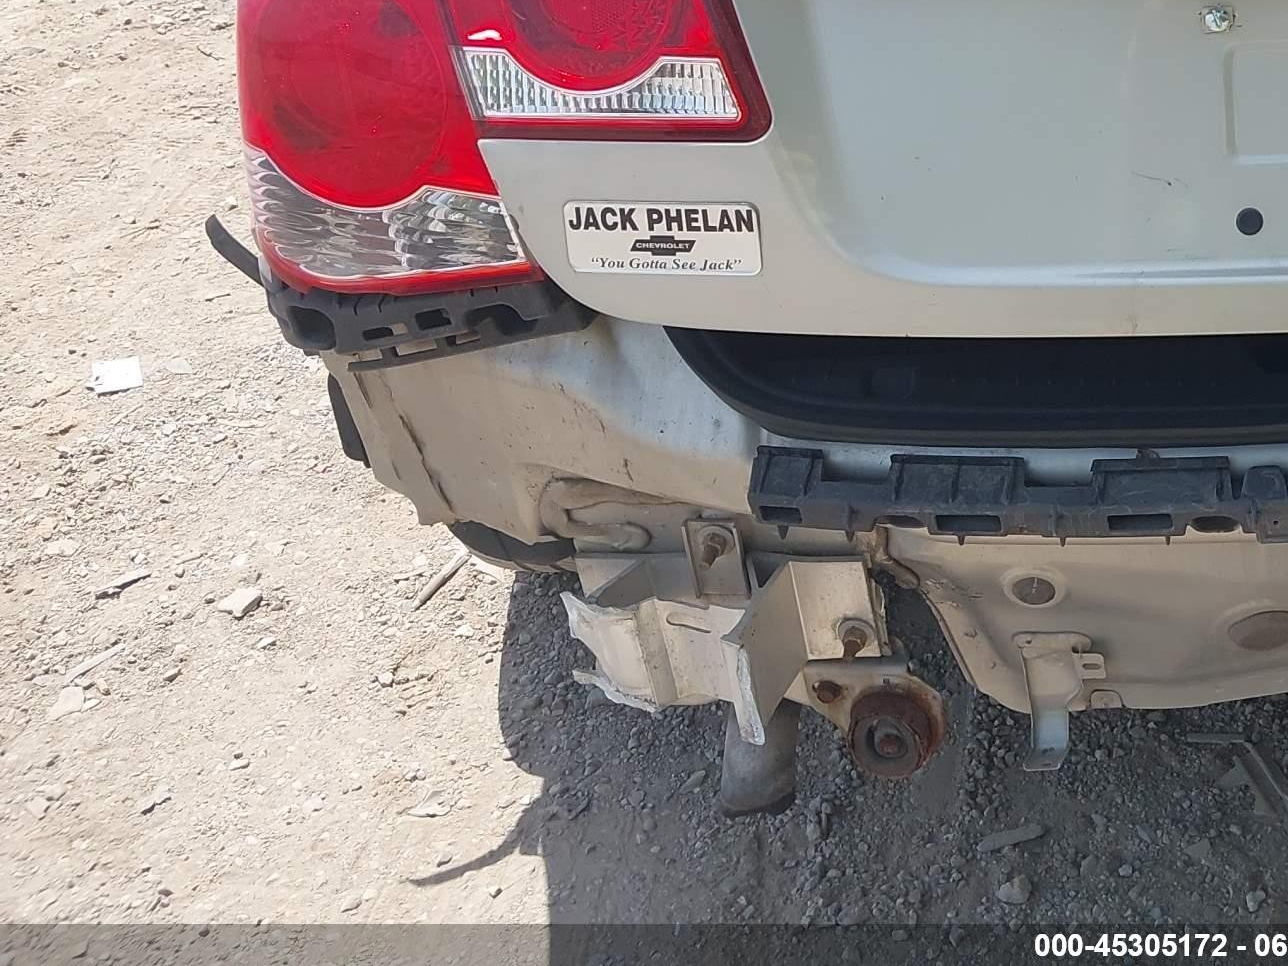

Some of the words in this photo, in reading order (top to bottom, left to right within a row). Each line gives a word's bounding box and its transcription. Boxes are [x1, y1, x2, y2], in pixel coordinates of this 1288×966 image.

[568, 206, 639, 232] JACK
[646, 208, 755, 233] PHELAN
[635, 242, 691, 250] CHEVROLET
[629, 257, 668, 270] Gotta
[671, 258, 696, 270] See
